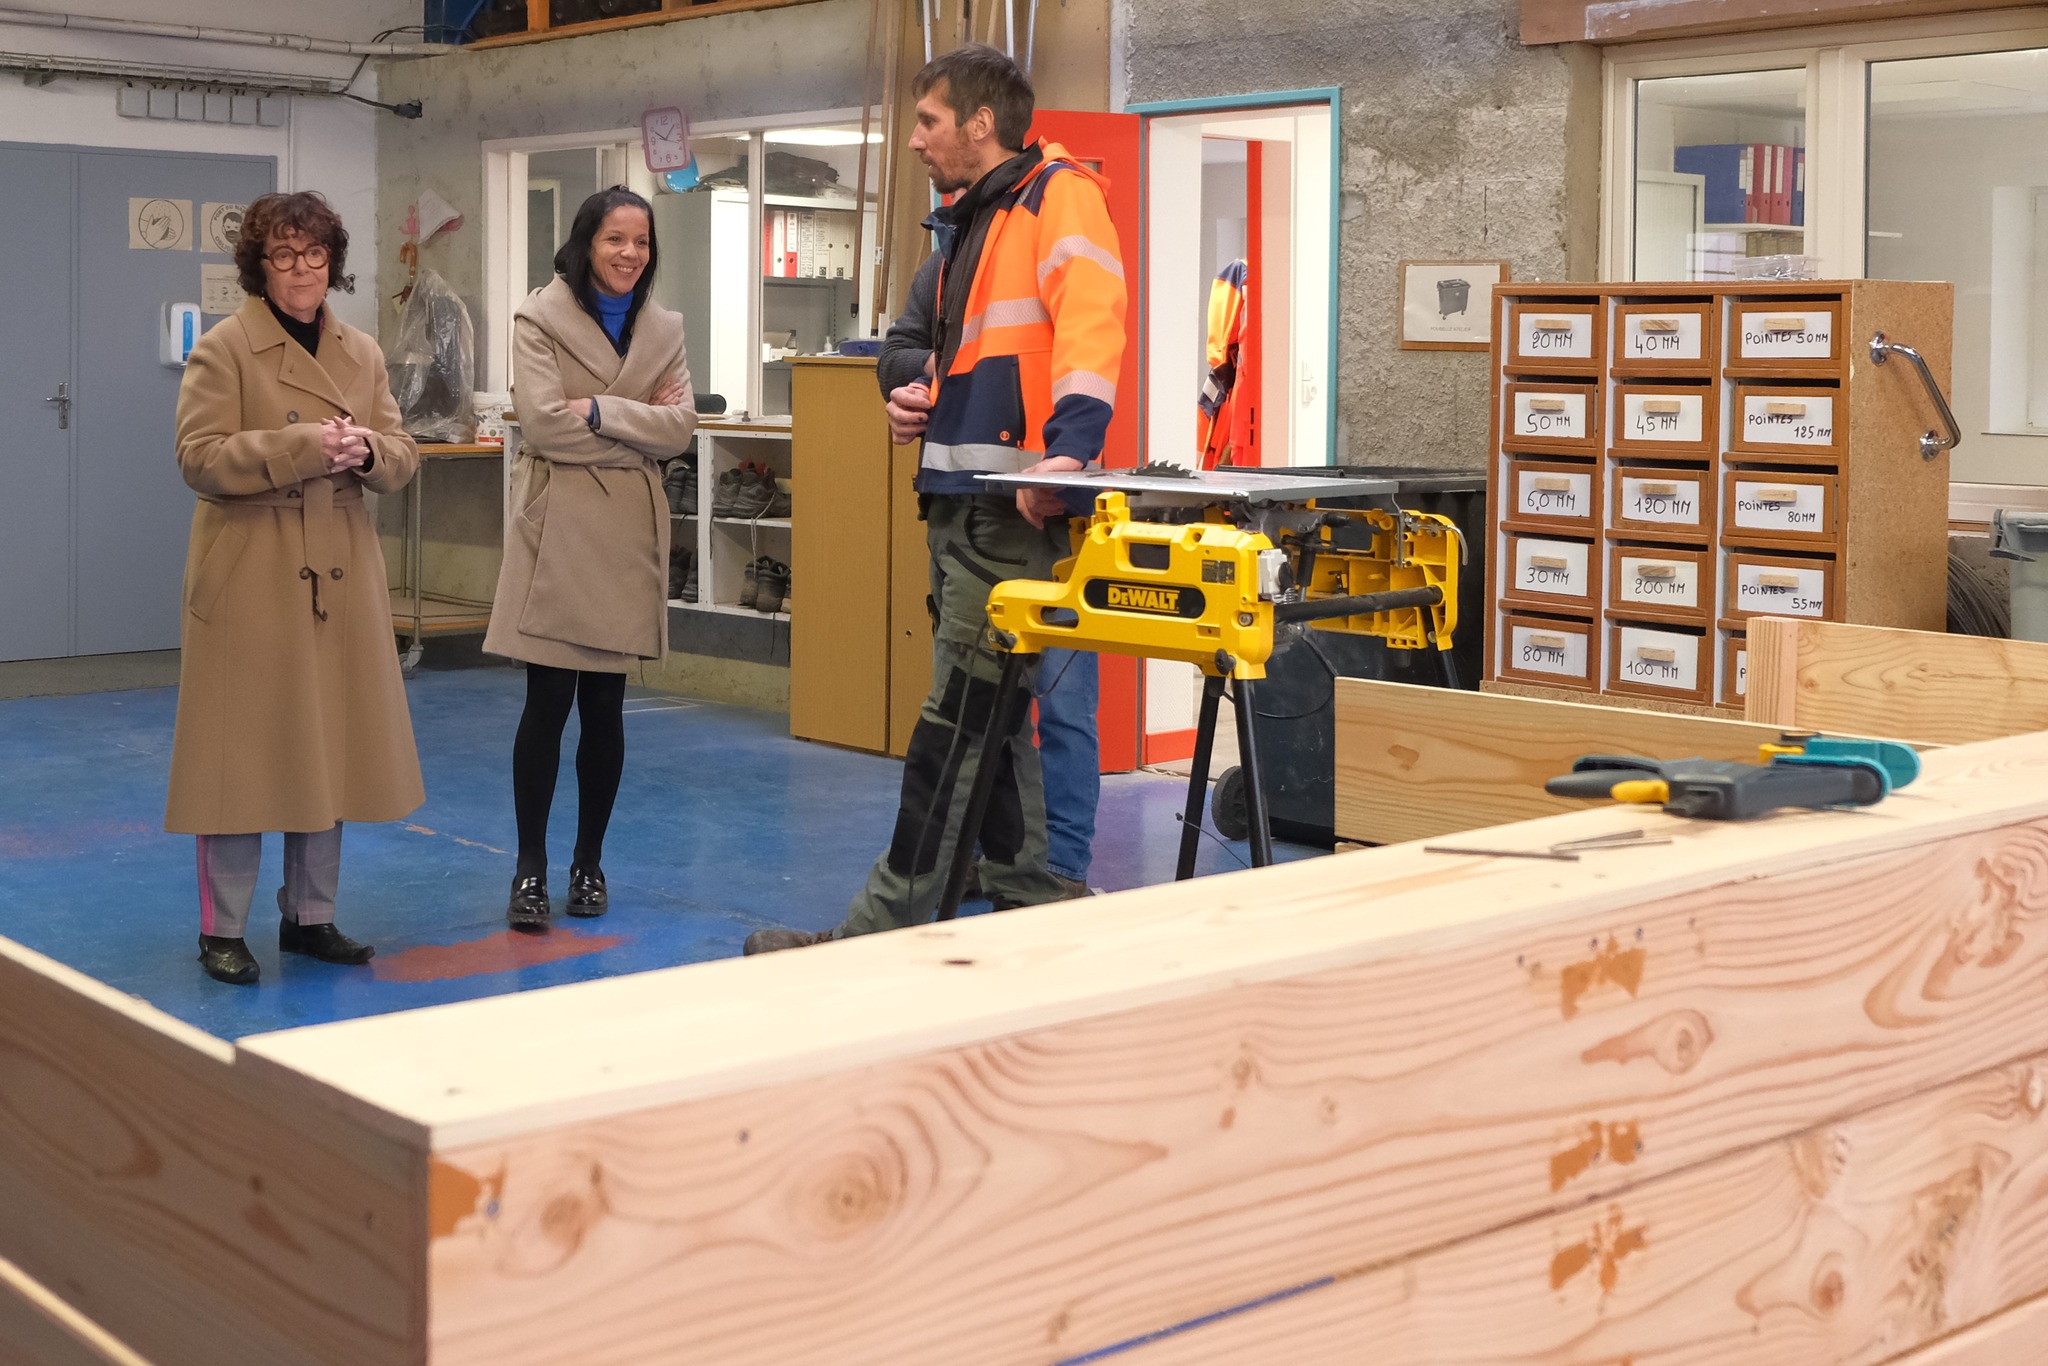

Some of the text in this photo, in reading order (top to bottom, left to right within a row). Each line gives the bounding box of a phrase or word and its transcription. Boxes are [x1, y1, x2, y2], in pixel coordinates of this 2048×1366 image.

[660, 115, 669, 126] 12
[1532, 331, 1550, 349] 20
[1635, 334, 1658, 354] 40
[1525, 413, 1551, 433] 50
[1636, 415, 1656, 435] 45
[1634, 497, 1666, 514] 120
[1526, 567, 1548, 583] 30
[1635, 578, 1663, 594] 200
[1522, 645, 1542, 662] 80
[1626, 660, 1653, 676] 100
